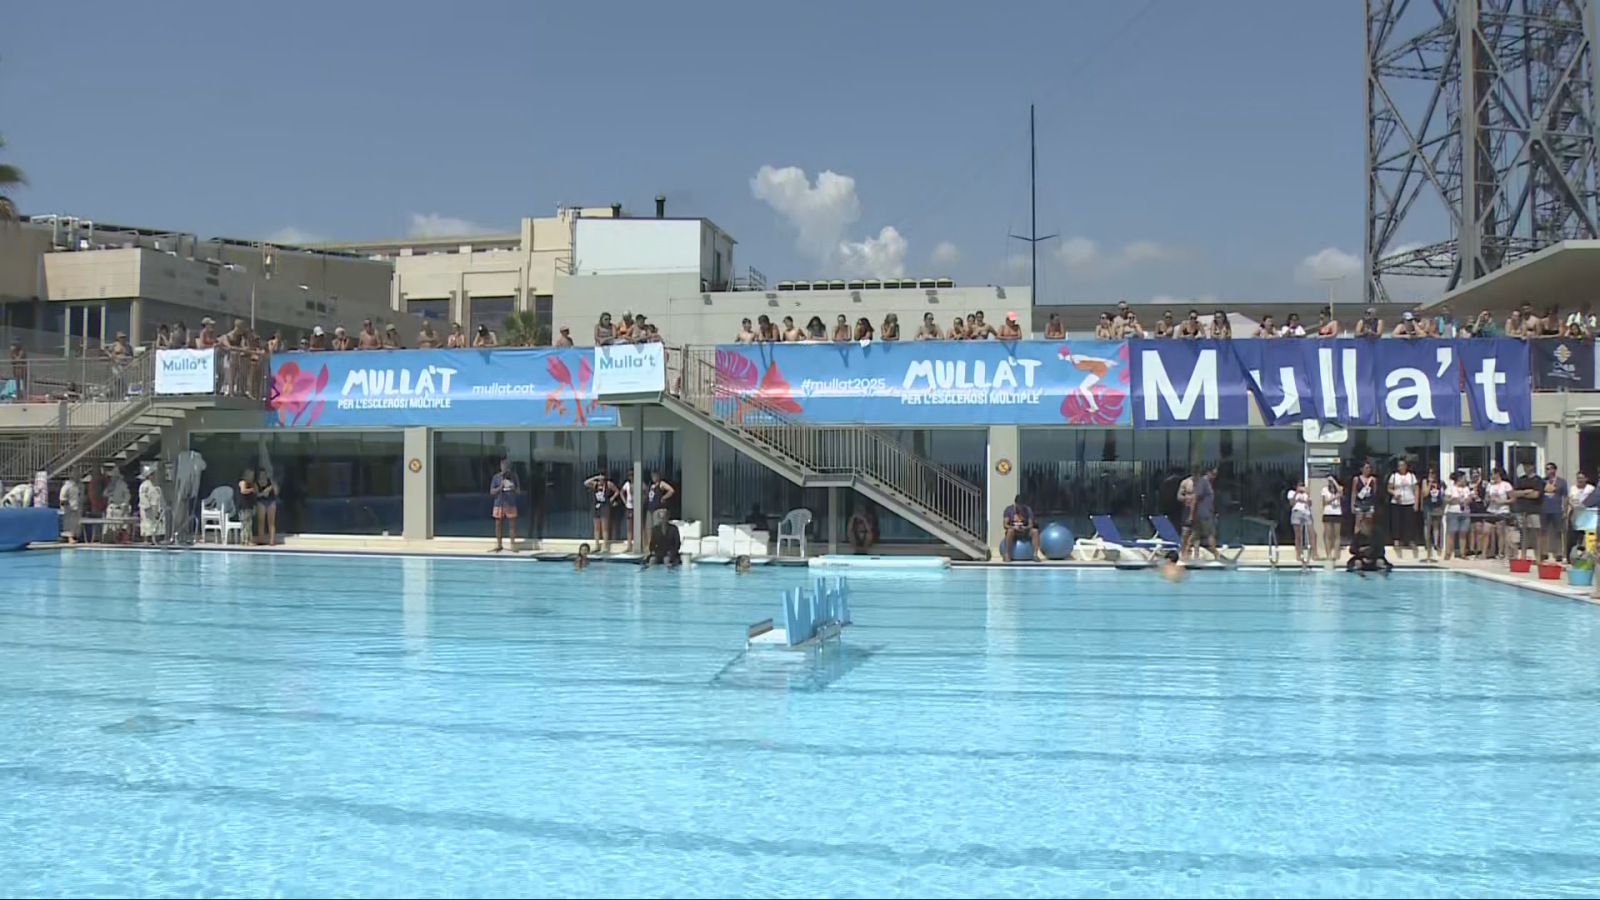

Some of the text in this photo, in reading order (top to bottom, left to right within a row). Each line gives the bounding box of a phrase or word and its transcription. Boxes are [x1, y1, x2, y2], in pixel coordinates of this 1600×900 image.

[163, 358, 207, 371] Mulla't
[600, 355, 656, 369] Mulla't
[472, 382, 535, 395] mullat.cat
[801, 378, 885, 390] #mullat2025
[1141, 347, 1510, 425] Mulla't
[337, 399, 354, 409] PER
[901, 393, 921, 404] PER
